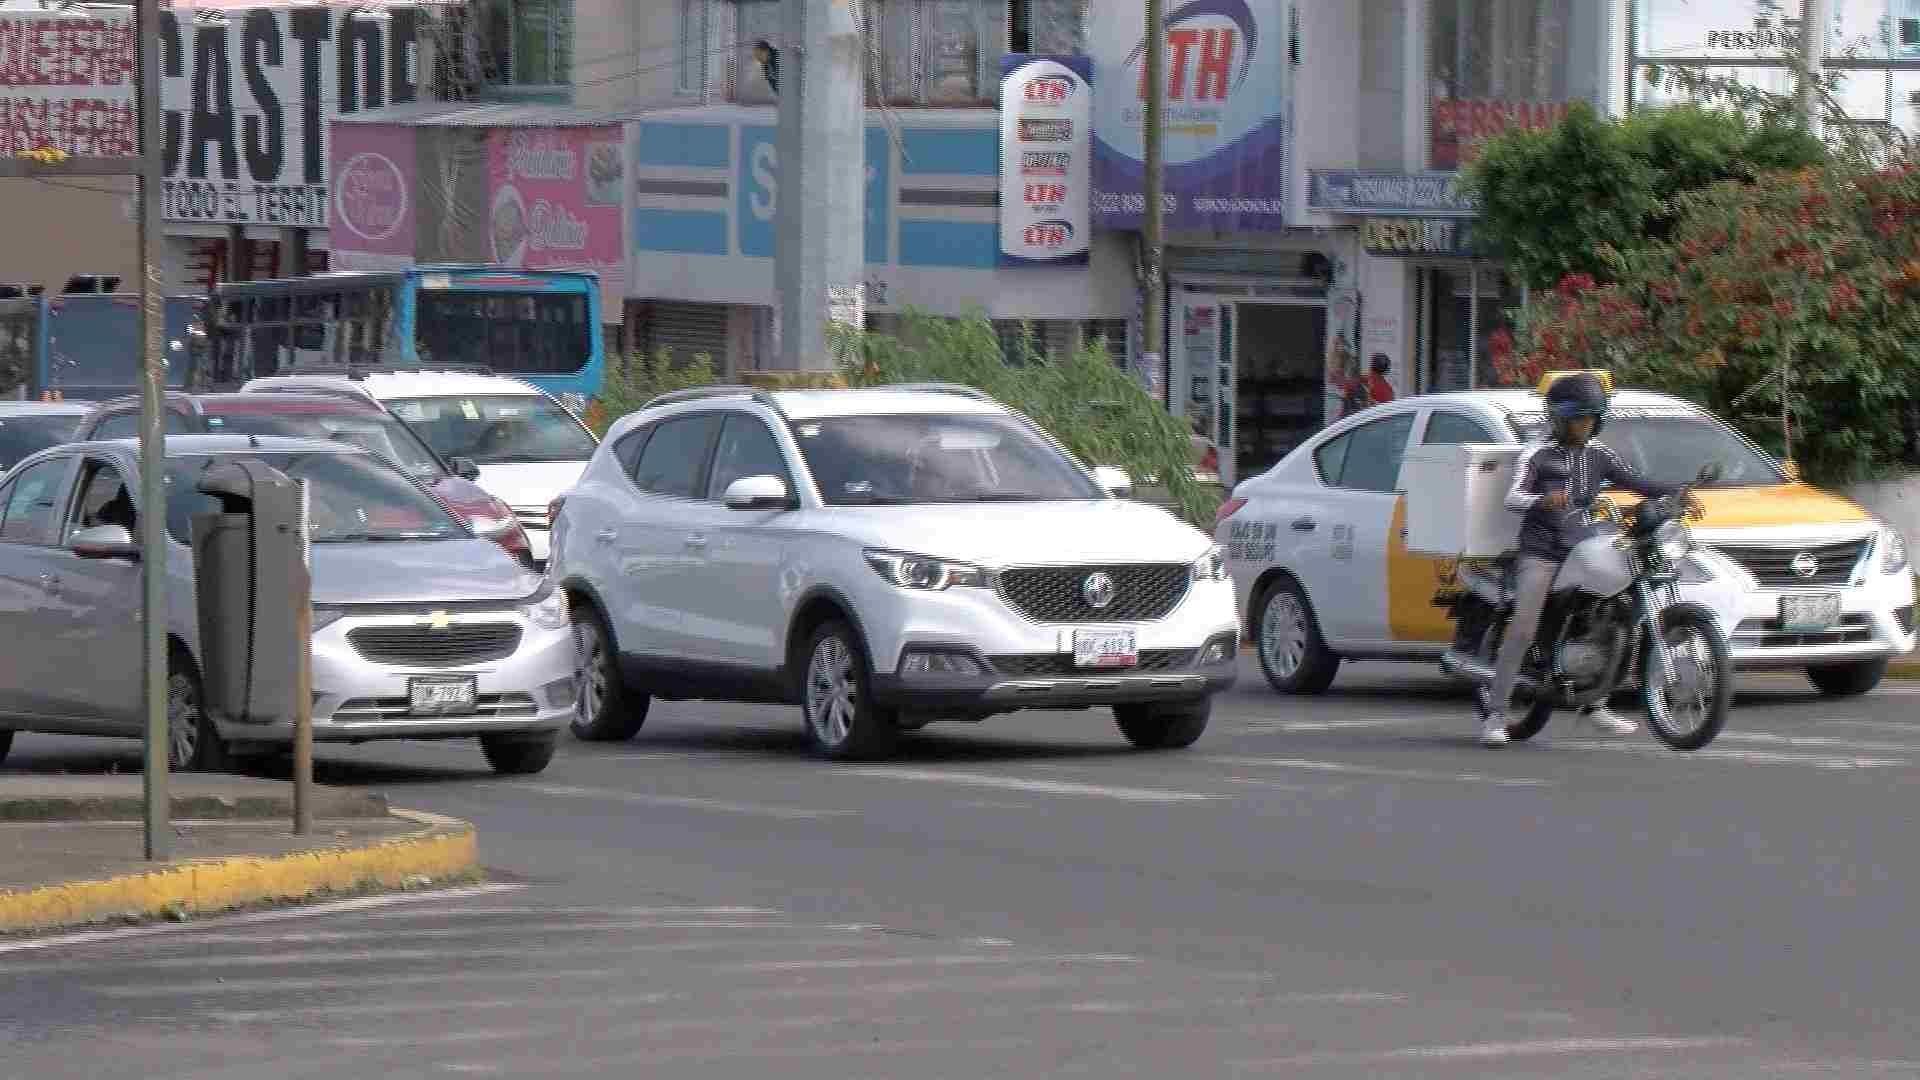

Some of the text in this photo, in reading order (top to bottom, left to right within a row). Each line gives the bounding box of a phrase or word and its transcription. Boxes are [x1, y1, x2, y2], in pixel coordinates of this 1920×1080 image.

[1024, 80, 1067, 100] LTH
[1023, 184, 1066, 203] LTH
[1023, 225, 1066, 245] LTH
